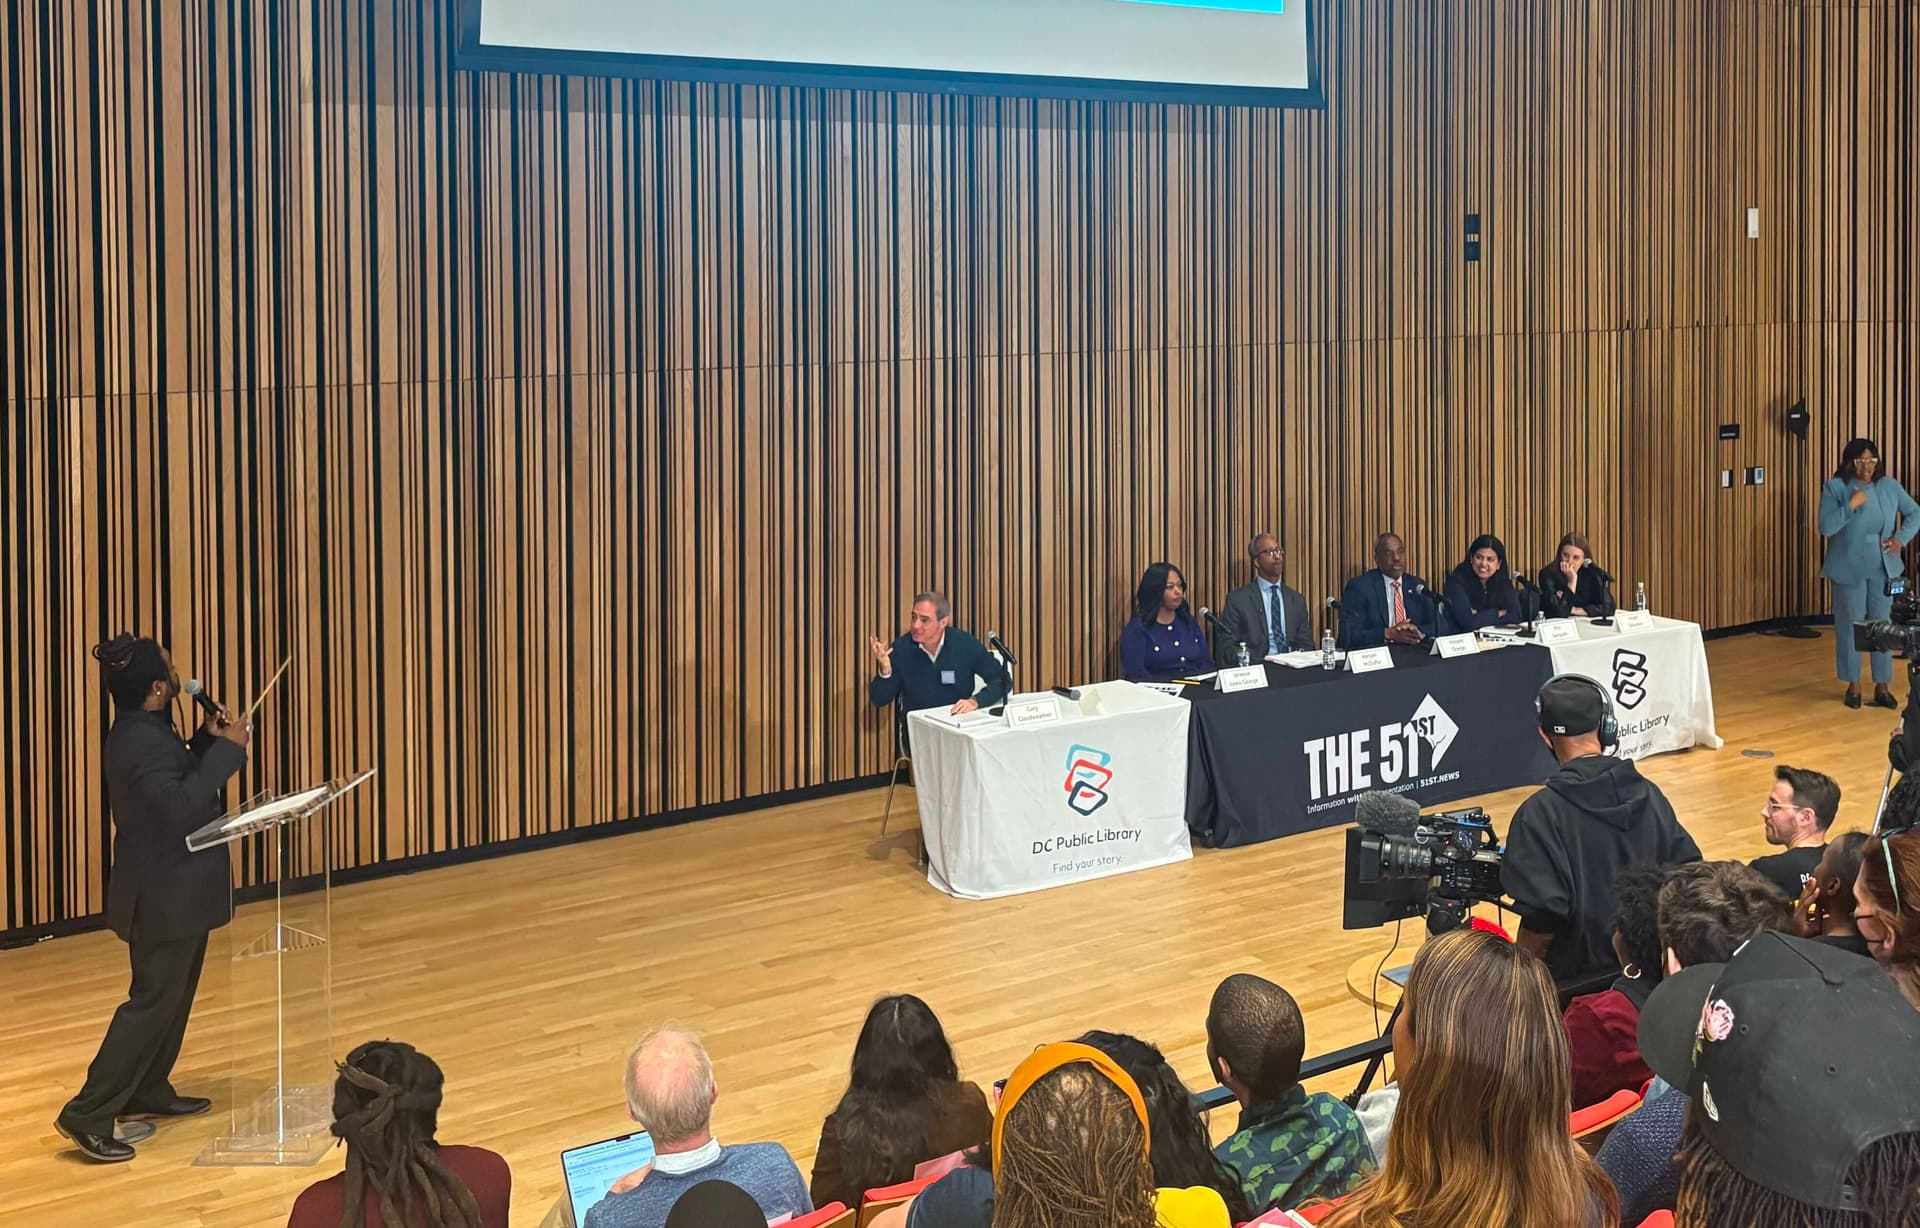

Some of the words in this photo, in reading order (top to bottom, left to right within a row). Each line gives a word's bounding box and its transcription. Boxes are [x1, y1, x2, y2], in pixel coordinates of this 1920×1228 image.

[1616, 723, 1638, 738] ublic
[1639, 714, 1670, 732] Library
[1303, 729, 1372, 800] THE
[1307, 796, 1346, 815] Information
[1420, 770, 1460, 788] 51ST.NEWS
[1032, 838, 1053, 855] DC
[1056, 832, 1095, 850] Public
[1096, 828, 1142, 843] Library
[1053, 861, 1073, 873] Find
[1075, 858, 1095, 873] your
